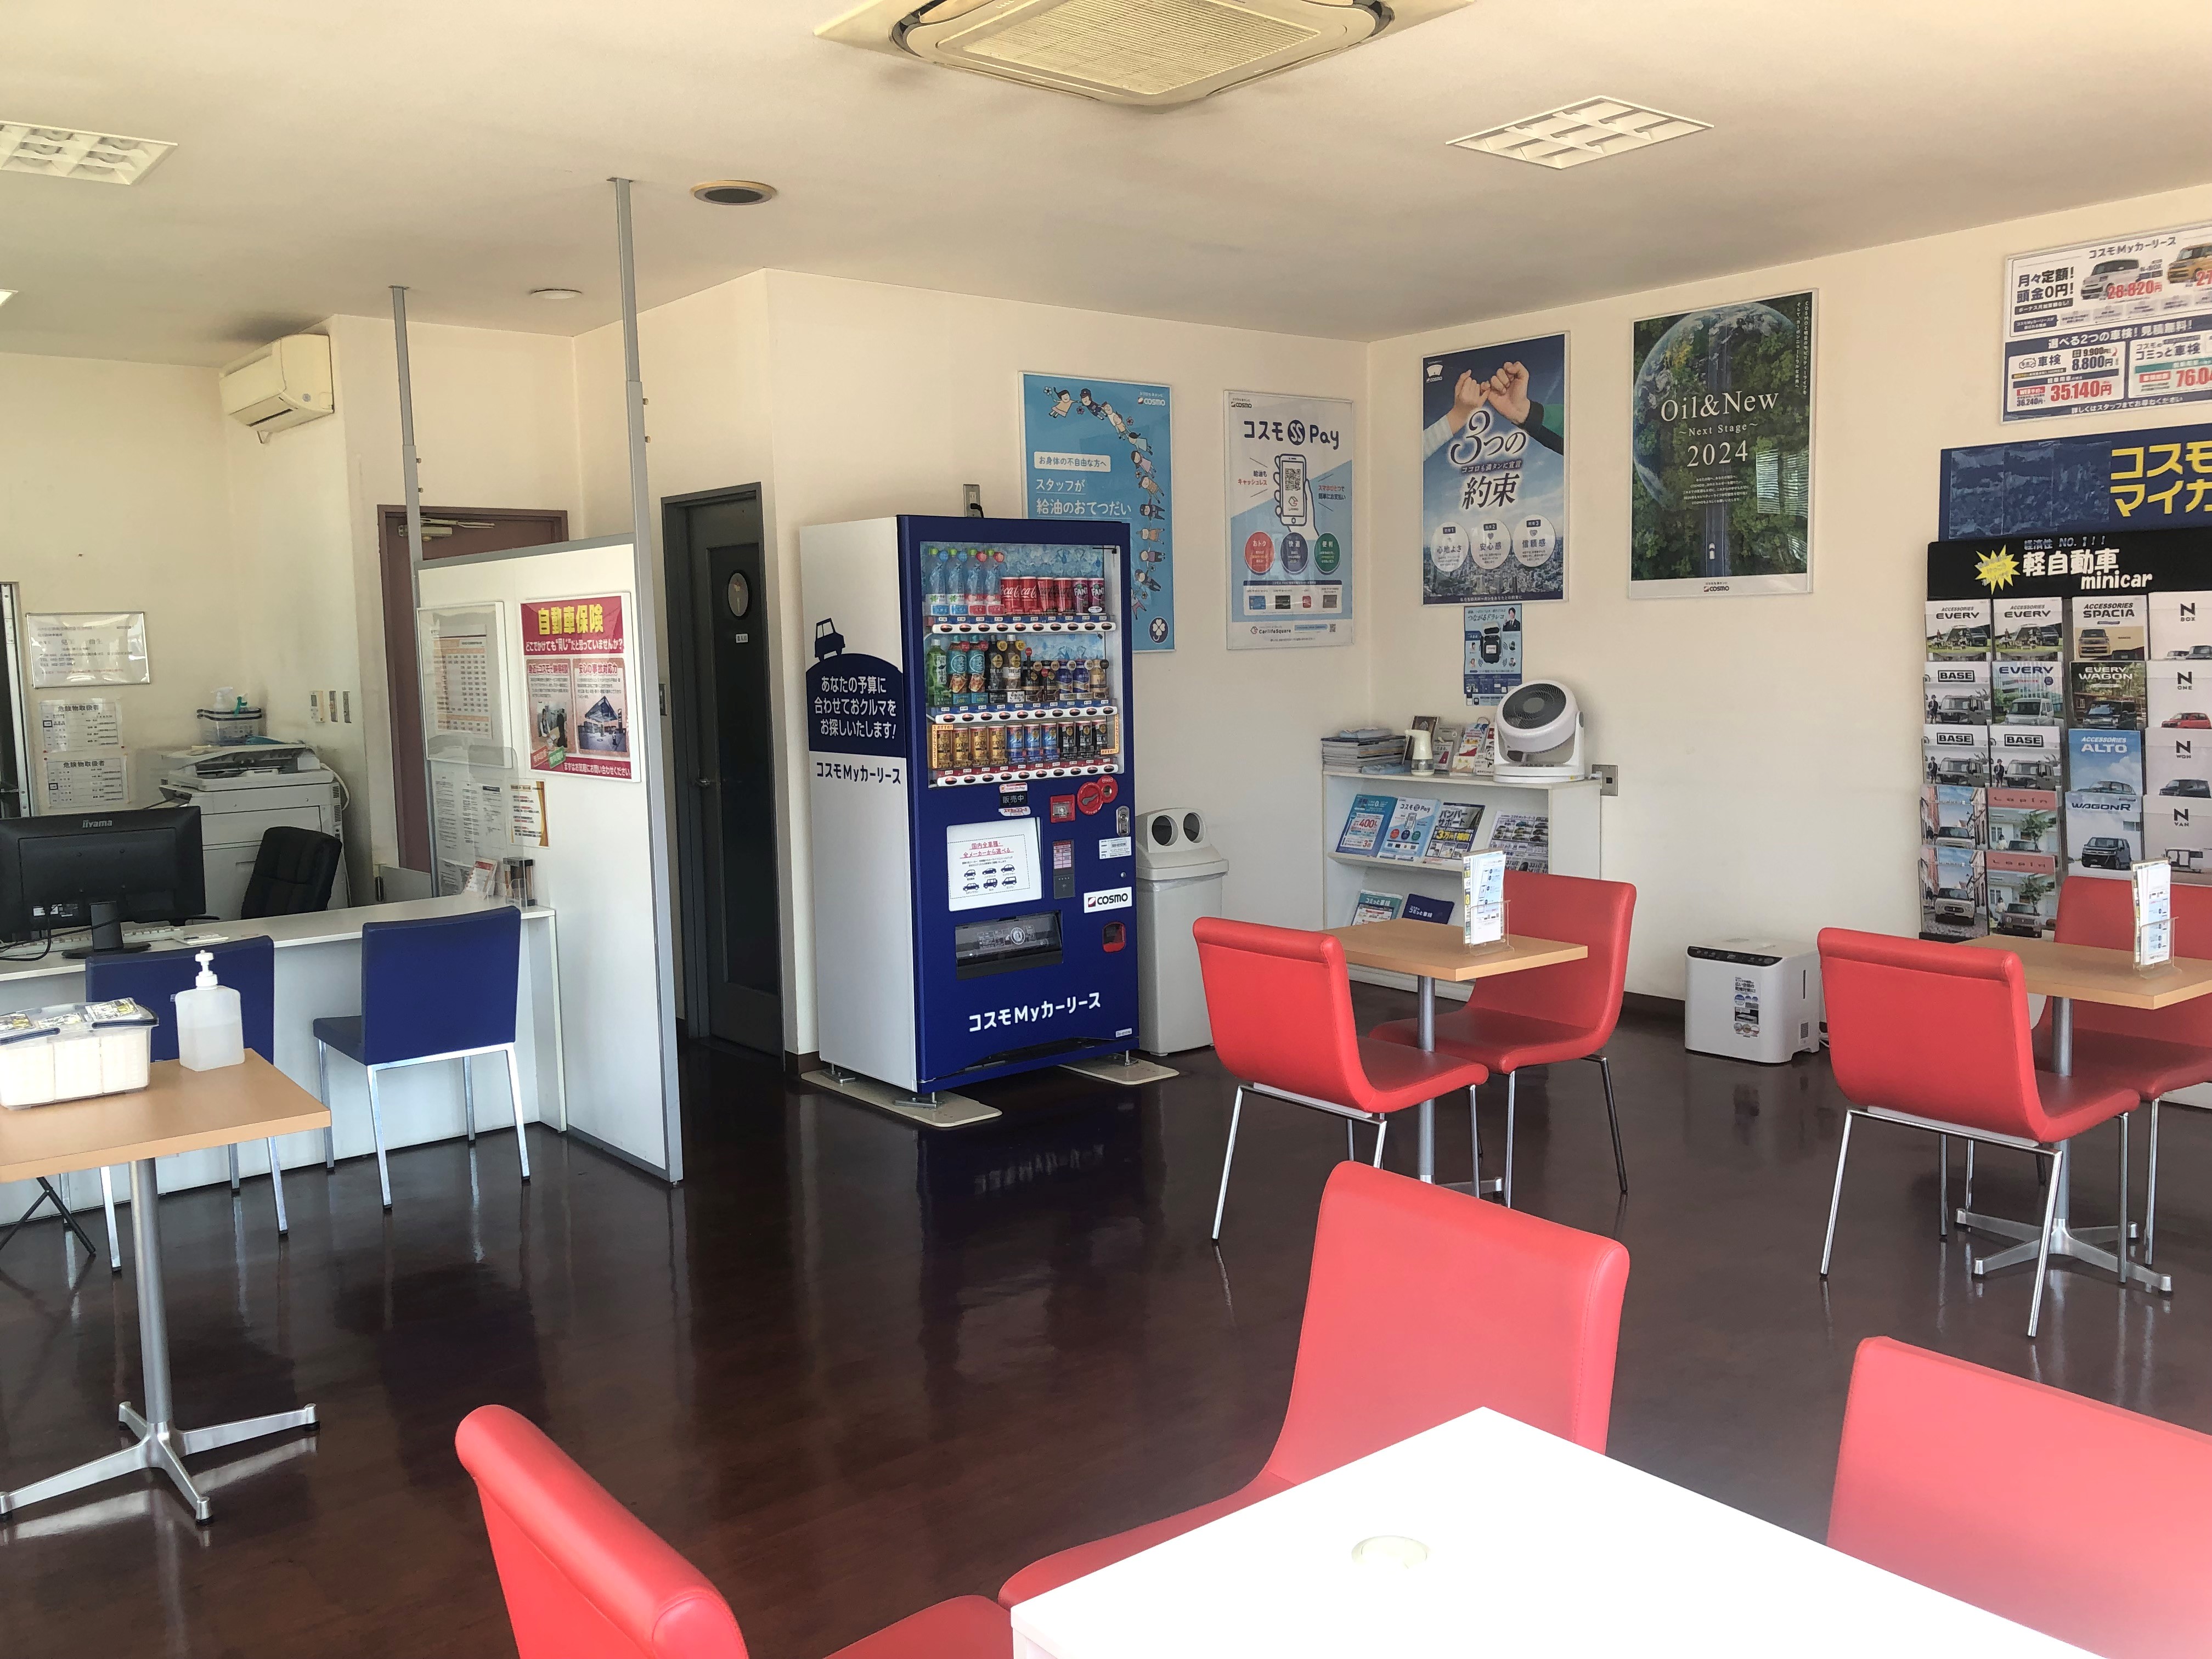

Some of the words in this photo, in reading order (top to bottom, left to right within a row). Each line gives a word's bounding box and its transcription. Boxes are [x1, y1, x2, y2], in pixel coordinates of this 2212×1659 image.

[2089, 236, 2176, 259] コスモMyカーリース
[2038, 354, 2061, 366] 車検
[1661, 391, 1780, 423] Oil&New
[1243, 420, 1283, 442] コスモ
[1310, 424, 1340, 450] Pay
[1449, 410, 1527, 465] 3つの
[1686, 439, 1749, 467] 2024
[1039, 455, 1107, 467] お身体の不自由な方へ
[1035, 478, 1085, 493] スタッフが
[1462, 473, 1520, 510] 約束
[1036, 498, 1131, 516] 給油のおてつだい
[2023, 548, 2120, 577] 軽自動車
[2081, 571, 2153, 590] minicar
[1936, 611, 1979, 619] EVERY
[2004, 610, 2051, 619] EVERY
[2083, 608, 2135, 619] SPACIA
[2180, 602, 2196, 617] N
[538, 603, 604, 635] 自動車保険
[578, 662, 618, 675] 安心の事故対応力
[1939, 671, 1973, 680] BASE
[1999, 665, 2054, 674] EVERY
[821, 675, 887, 695] あなたの予算に
[2177, 671, 2193, 685] N
[814, 696, 896, 716] 合わせておクルマを
[821, 718, 896, 740] お探しいたします!
[1938, 734, 1973, 743] BASE
[2006, 736, 2042, 745] BASE
[2081, 743, 2128, 753] ALTO
[2175, 740, 2191, 754] N
[816, 762, 901, 785] コスモMyカーリース
[1002, 795, 1024, 804] 販売中
[1439, 810, 1468, 819] バンパー
[2173, 808, 2189, 822] N
[82, 819, 112, 828] iiyama
[963, 848, 1011, 858] 全メーカーから選べる
[1097, 893, 1128, 905] COSMO
[969, 991, 1102, 1032] コスモMyカーリース
